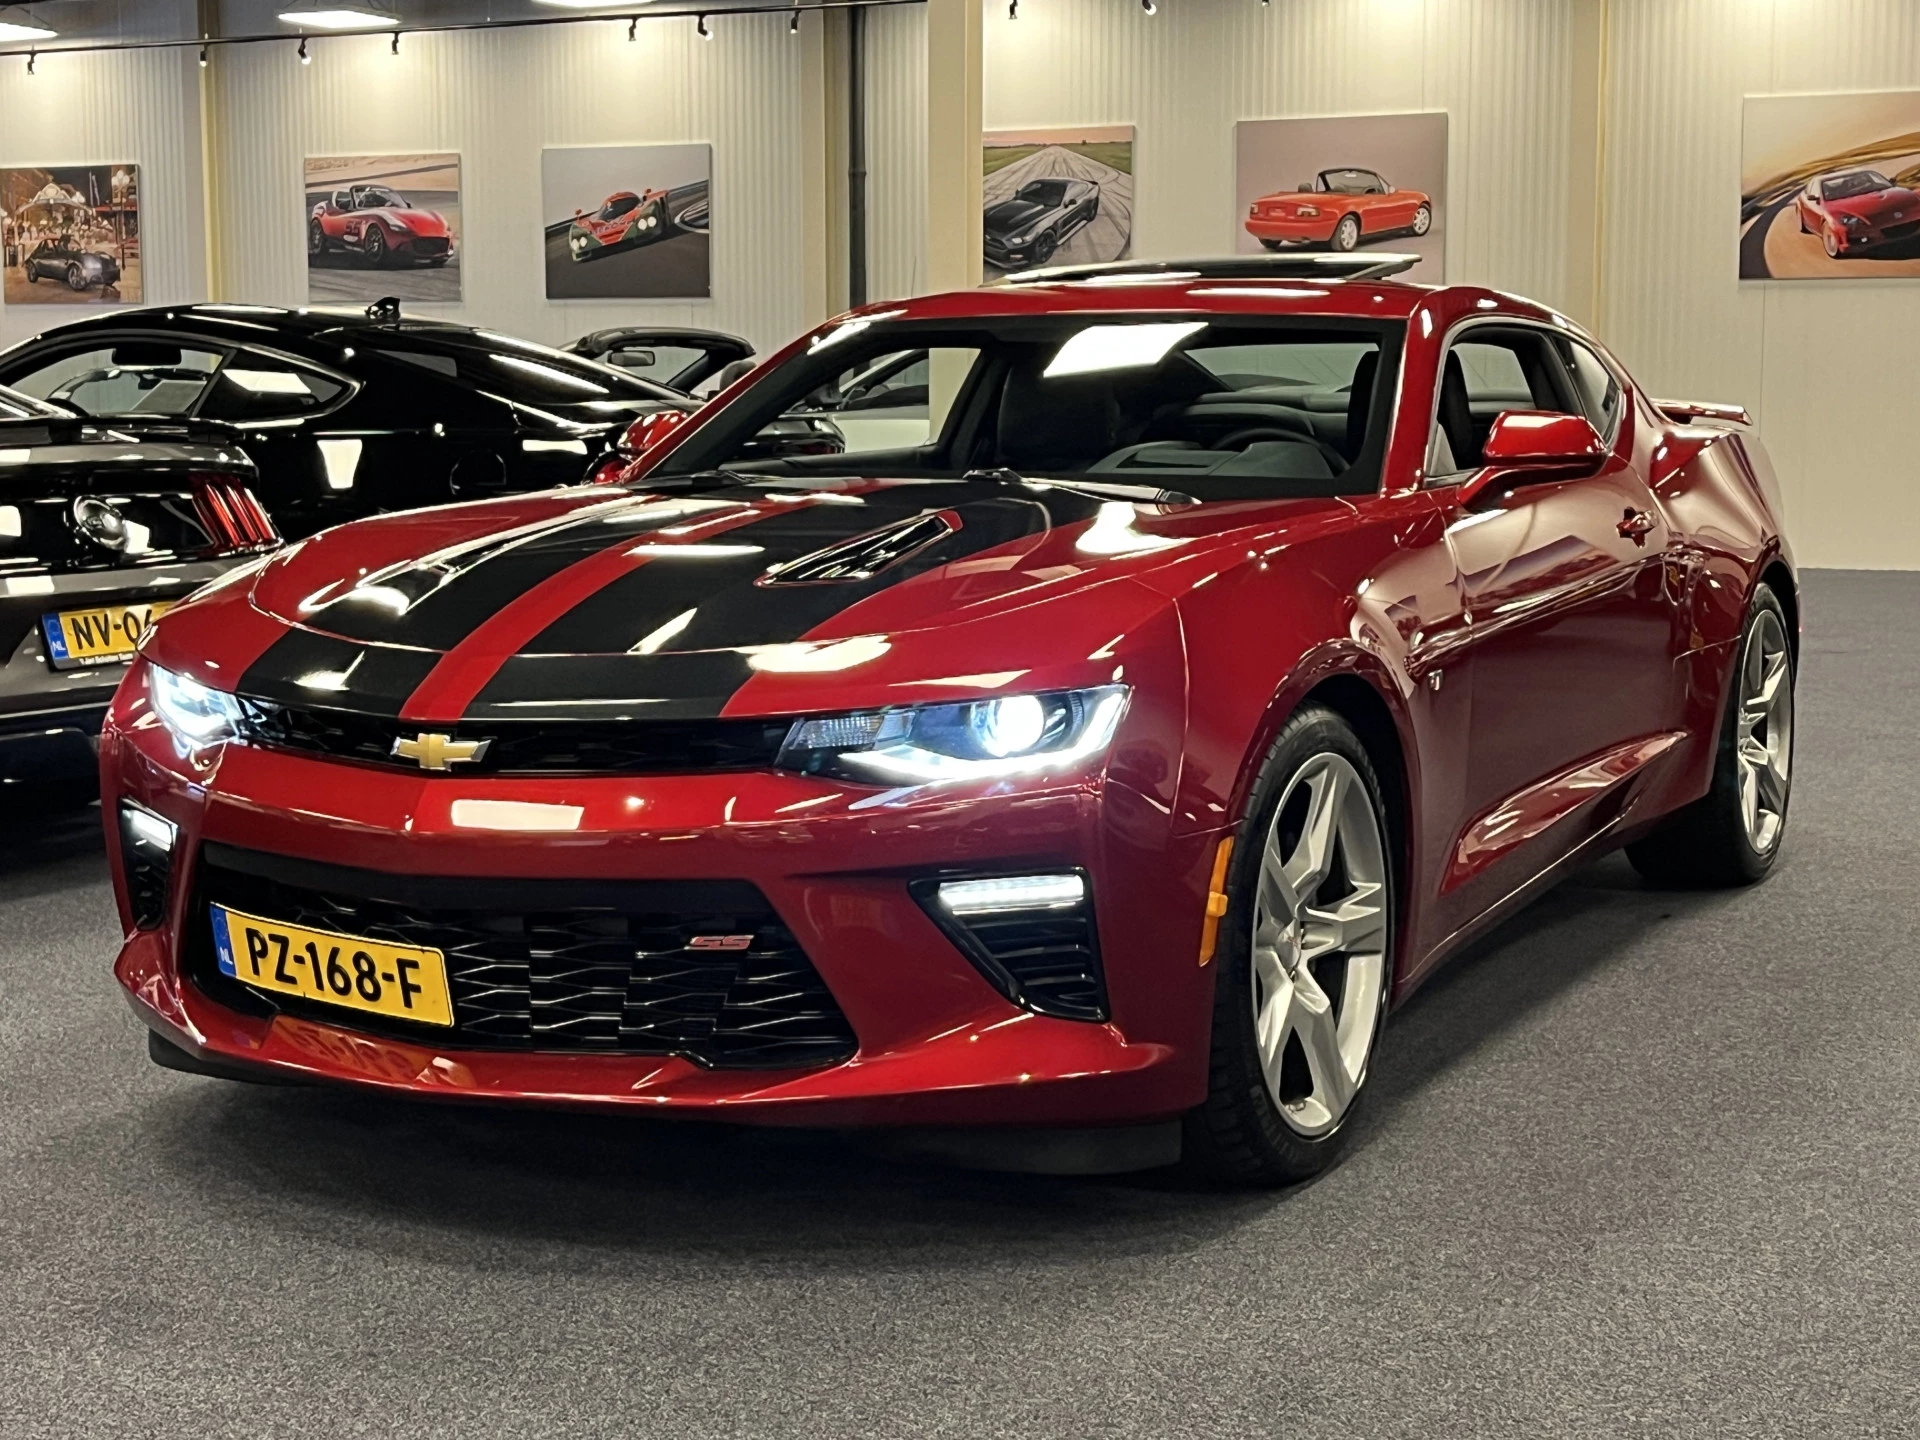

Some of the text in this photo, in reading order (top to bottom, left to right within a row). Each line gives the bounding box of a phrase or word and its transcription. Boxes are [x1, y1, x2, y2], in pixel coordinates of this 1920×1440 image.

[51, 640, 66, 650] NL
[684, 934, 754, 950] SS
[219, 946, 233, 965] NL
[245, 927, 422, 1009] PZ-168-F
